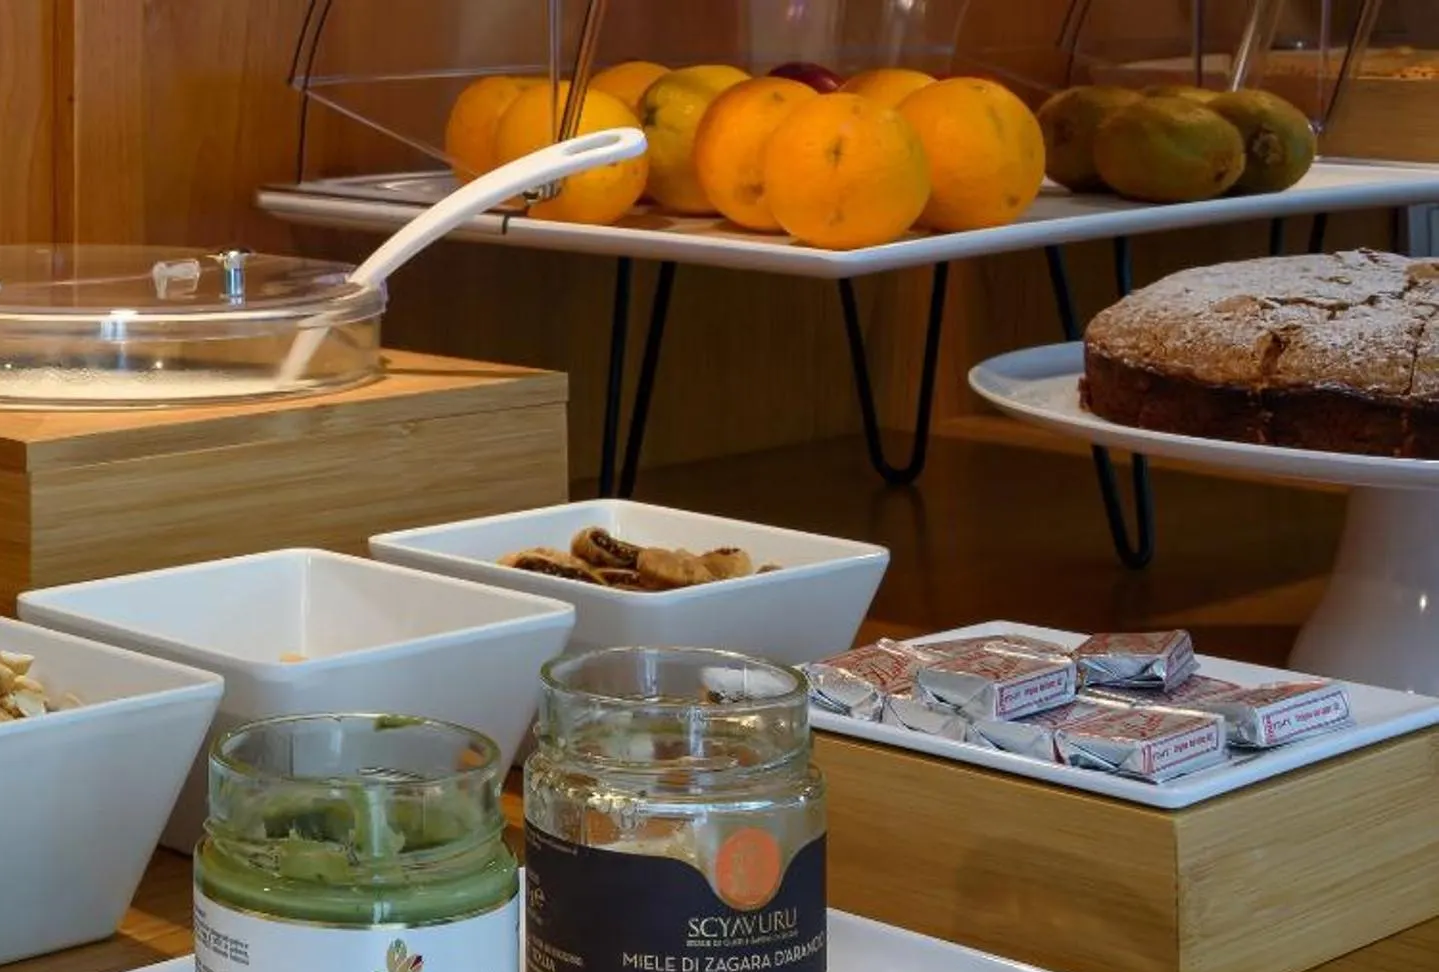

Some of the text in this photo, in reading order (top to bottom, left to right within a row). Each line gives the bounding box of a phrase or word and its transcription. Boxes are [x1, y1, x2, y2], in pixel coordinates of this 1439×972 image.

[686, 906, 798, 939] SCYAVURU
[621, 951, 677, 972] MIELE
[681, 956, 700, 972] DI
